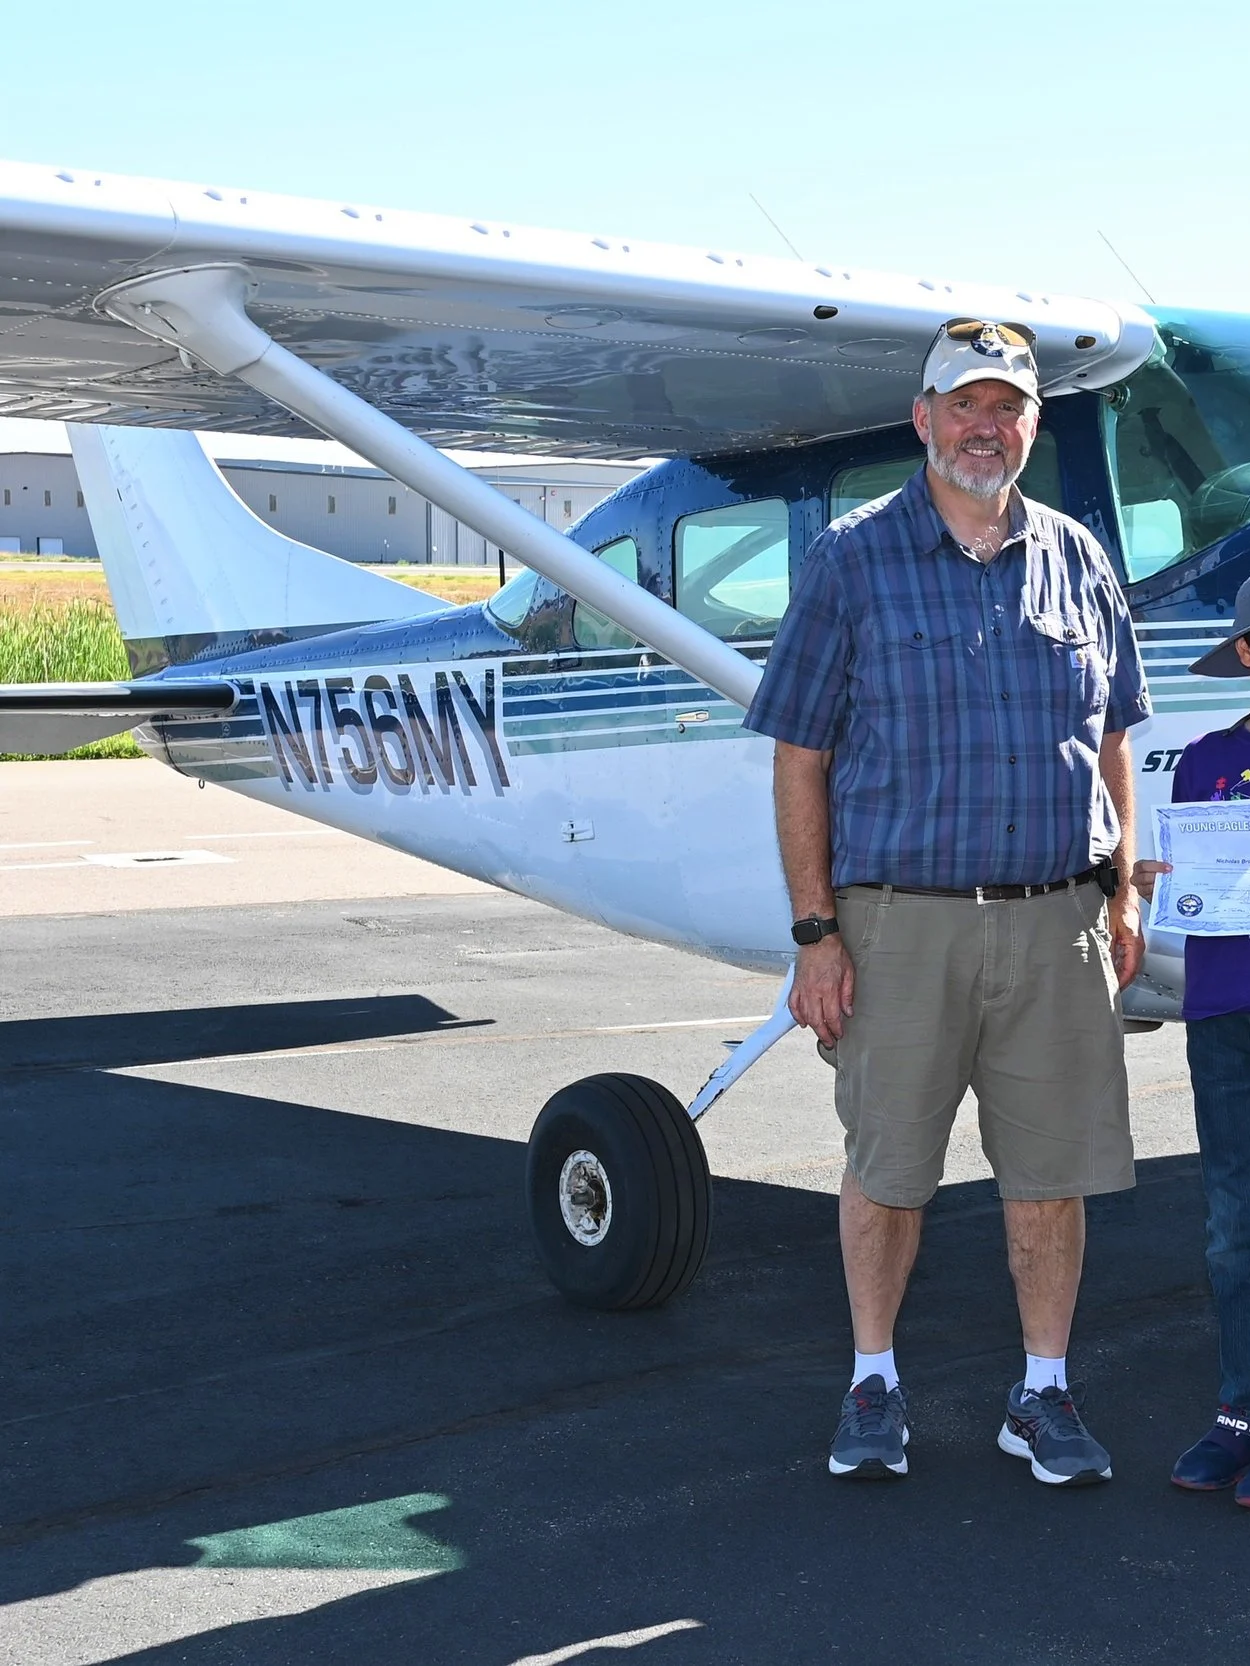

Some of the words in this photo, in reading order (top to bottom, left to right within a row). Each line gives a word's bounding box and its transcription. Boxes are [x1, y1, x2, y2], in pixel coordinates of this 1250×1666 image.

[259, 667, 511, 793] N756MY
[1141, 749, 1184, 773] ST
[1179, 822, 1216, 833] YOUNG
